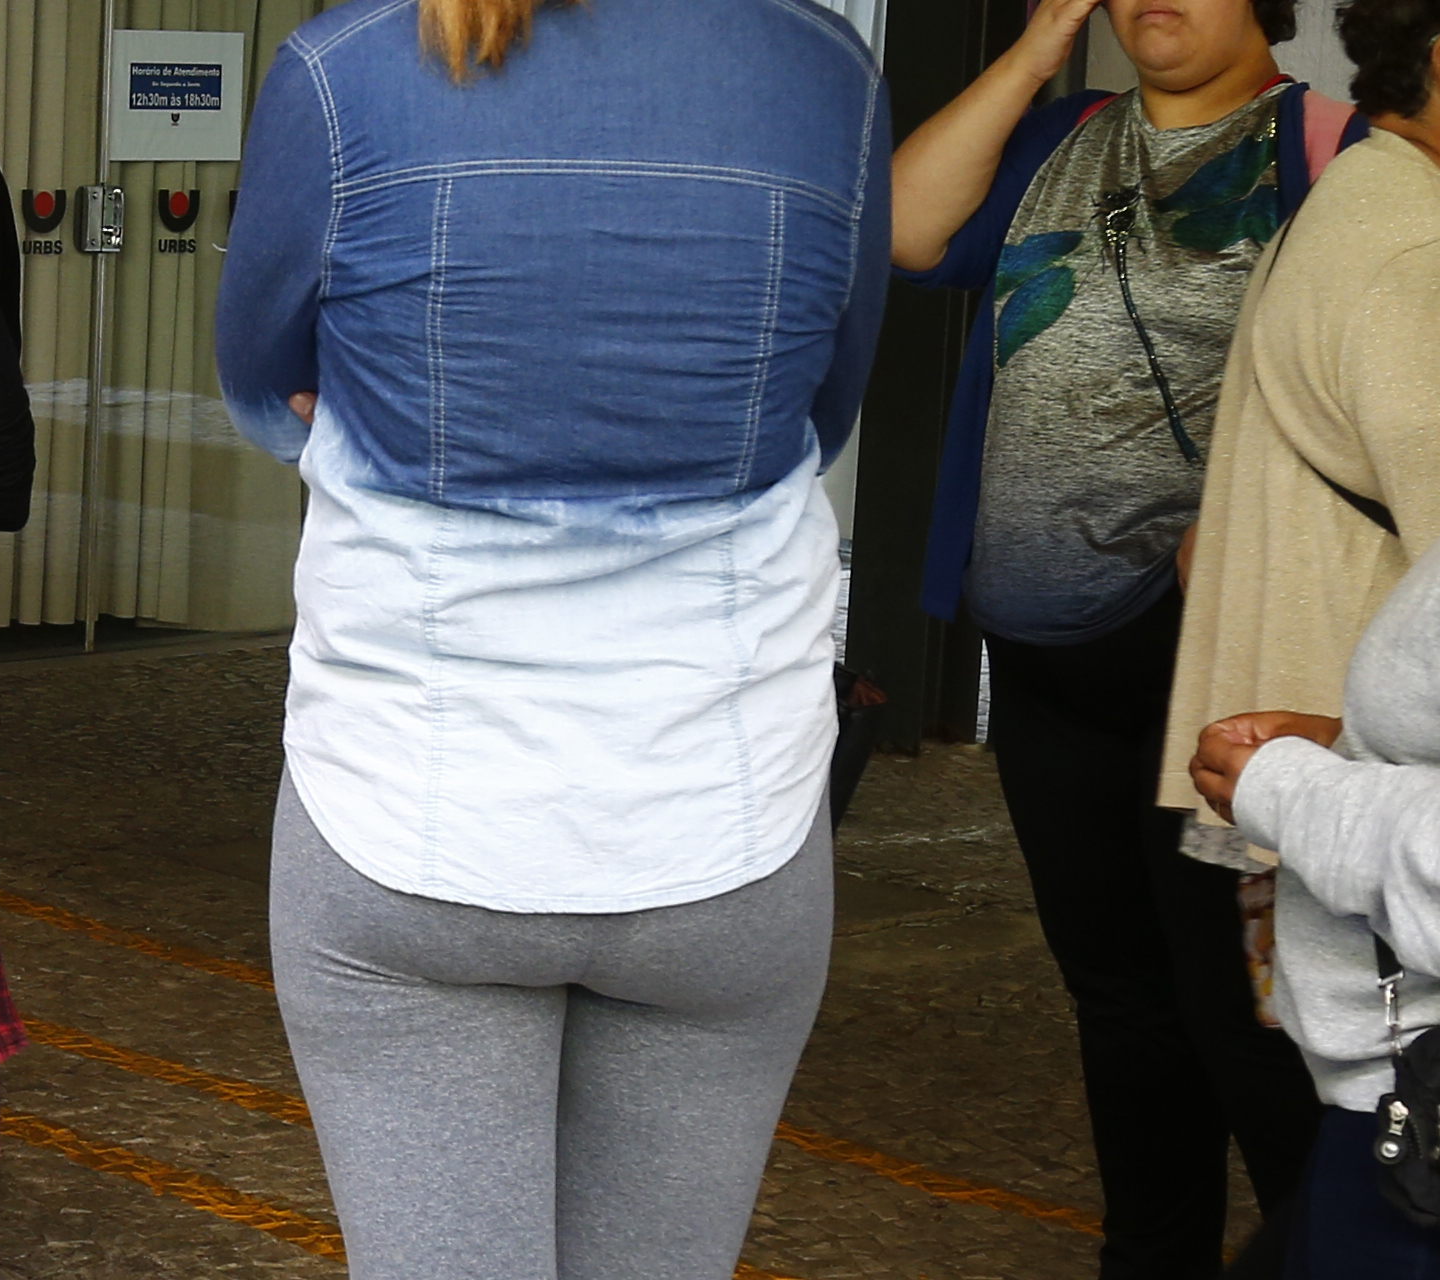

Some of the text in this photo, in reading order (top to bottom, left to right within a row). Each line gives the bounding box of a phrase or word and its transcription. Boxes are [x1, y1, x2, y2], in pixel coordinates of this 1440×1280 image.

[132, 67, 160, 75] Horário
[163, 67, 172, 76] de
[132, 93, 219, 106] 12h30m às 18h30m
[22, 240, 63, 254] URBS
[159, 239, 196, 253] URBS
